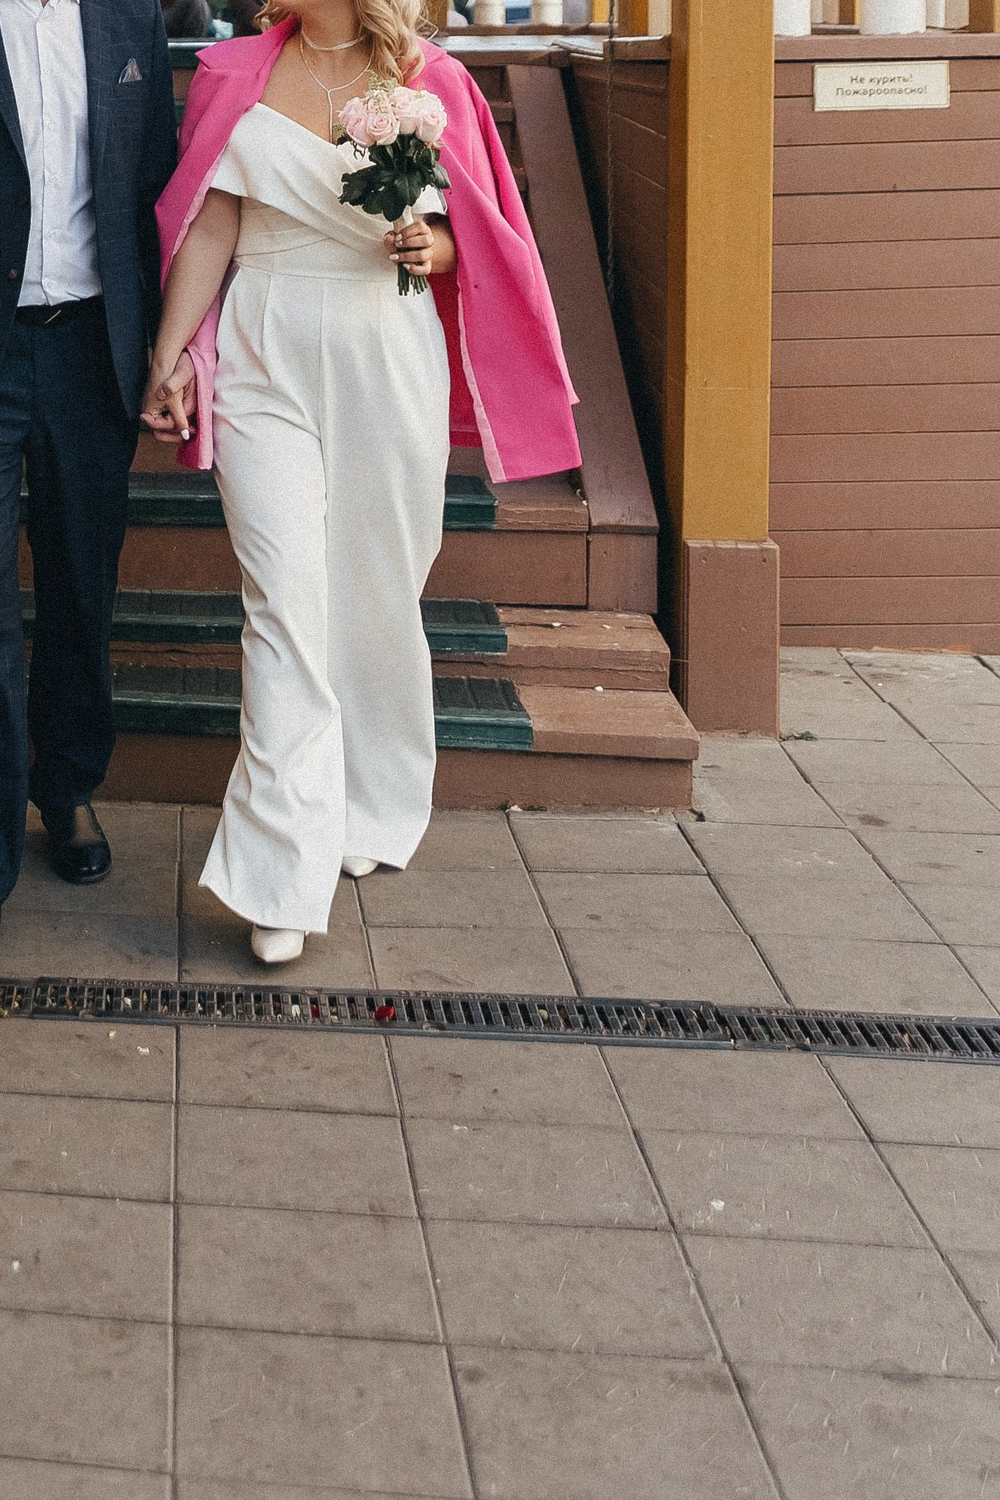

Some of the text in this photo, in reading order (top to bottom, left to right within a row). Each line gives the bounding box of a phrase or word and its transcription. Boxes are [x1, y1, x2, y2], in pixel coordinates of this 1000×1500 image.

[850, 73, 913, 85] Не курить!
[835, 85, 928, 97] Пожароопасно!
